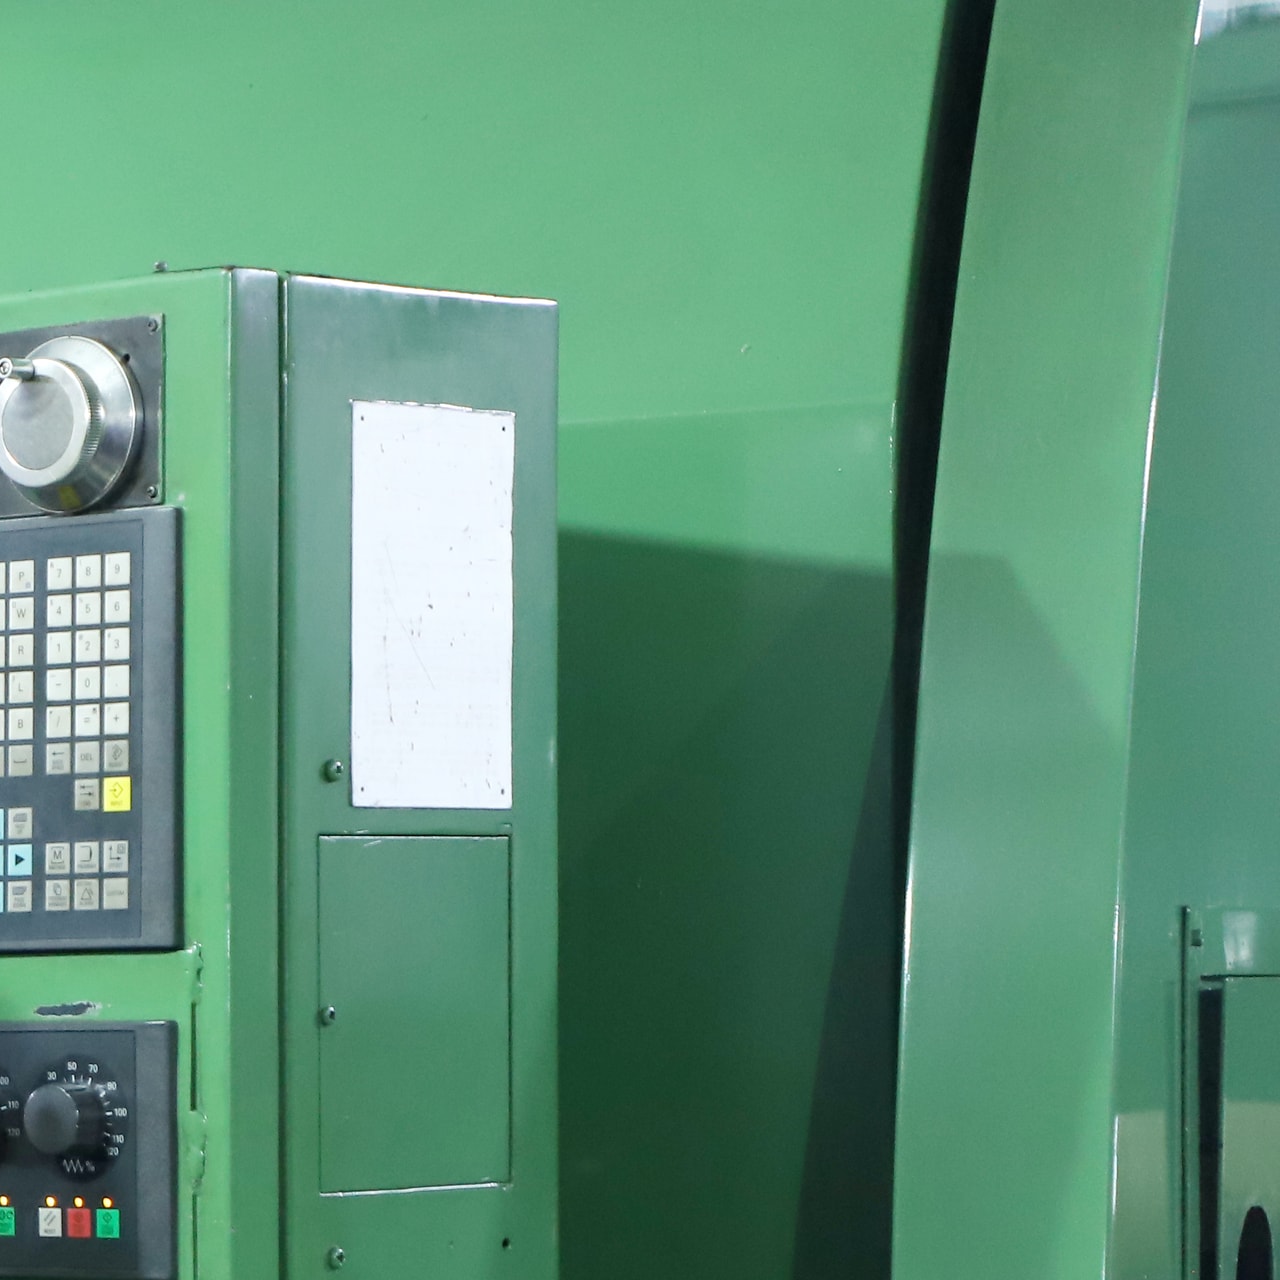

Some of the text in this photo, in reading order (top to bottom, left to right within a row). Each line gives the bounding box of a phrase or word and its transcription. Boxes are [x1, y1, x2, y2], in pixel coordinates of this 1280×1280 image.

[85, 566, 92, 577] 8
[114, 564, 120, 574] 9
[18, 571, 25, 582] P
[16, 608, 27, 618] W
[56, 606, 62, 615] 4
[18, 644, 24, 655] R
[17, 719, 24, 729] B
[88, 1064, 98, 1073] 70
[47, 1071, 57, 1080] 30
[8, 1100, 20, 1109] 110
[114, 1108, 128, 1117] 100
[112, 1134, 124, 1144] 110
